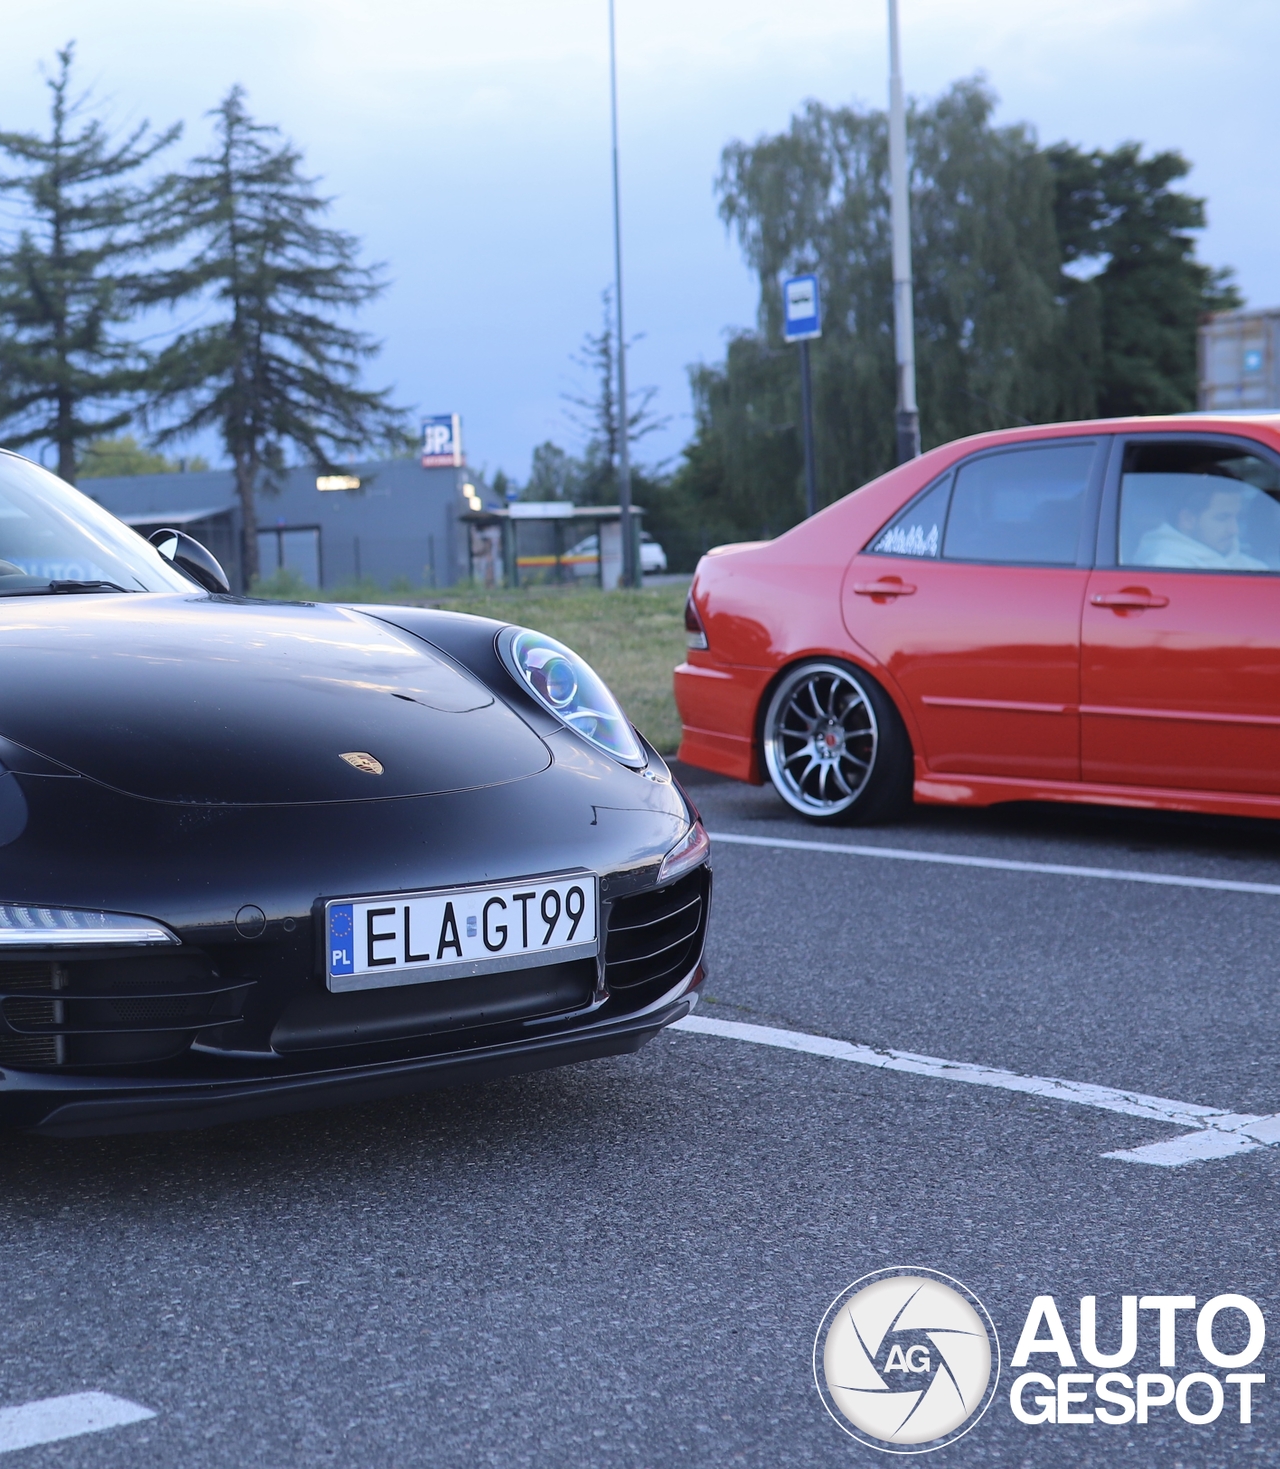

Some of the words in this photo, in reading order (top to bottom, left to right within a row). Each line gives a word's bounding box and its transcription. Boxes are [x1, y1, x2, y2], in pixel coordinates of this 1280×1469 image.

[367, 901, 462, 967] ELA
[482, 885, 585, 952] GT99
[332, 950, 351, 966] PL
